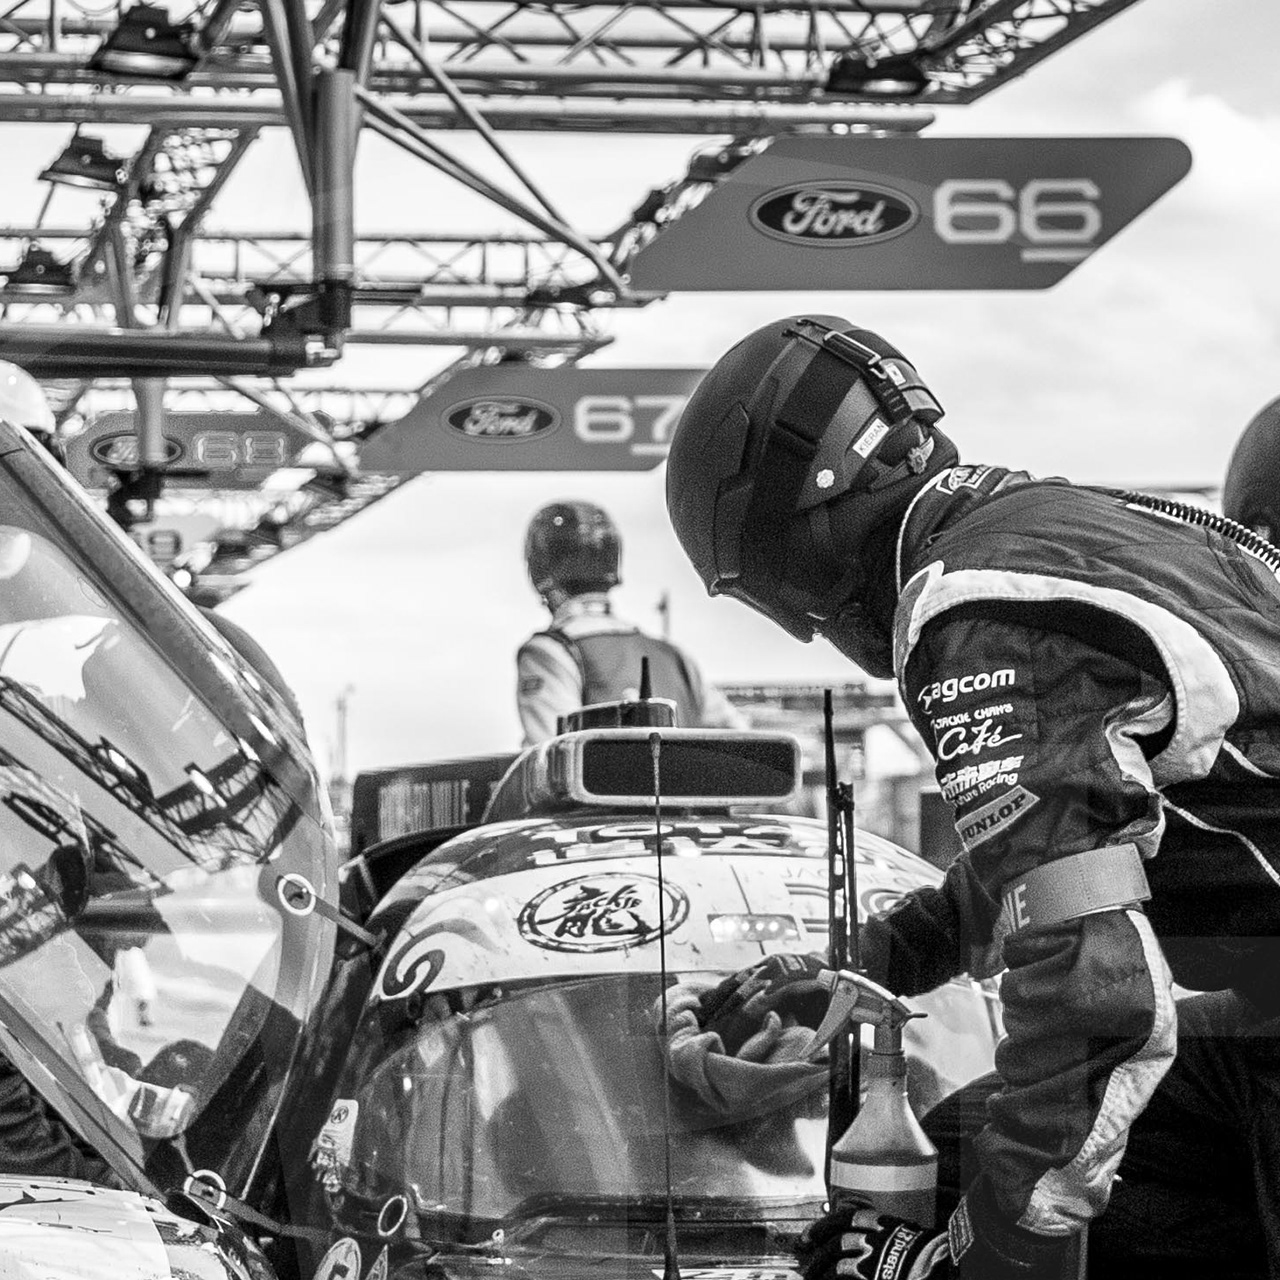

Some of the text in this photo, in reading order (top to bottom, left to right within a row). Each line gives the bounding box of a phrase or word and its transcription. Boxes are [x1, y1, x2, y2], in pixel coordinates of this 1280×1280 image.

[783, 178, 1102, 243] Ford 66
[465, 400, 540, 438] Ford
[935, 711, 971, 729] JACKIE
